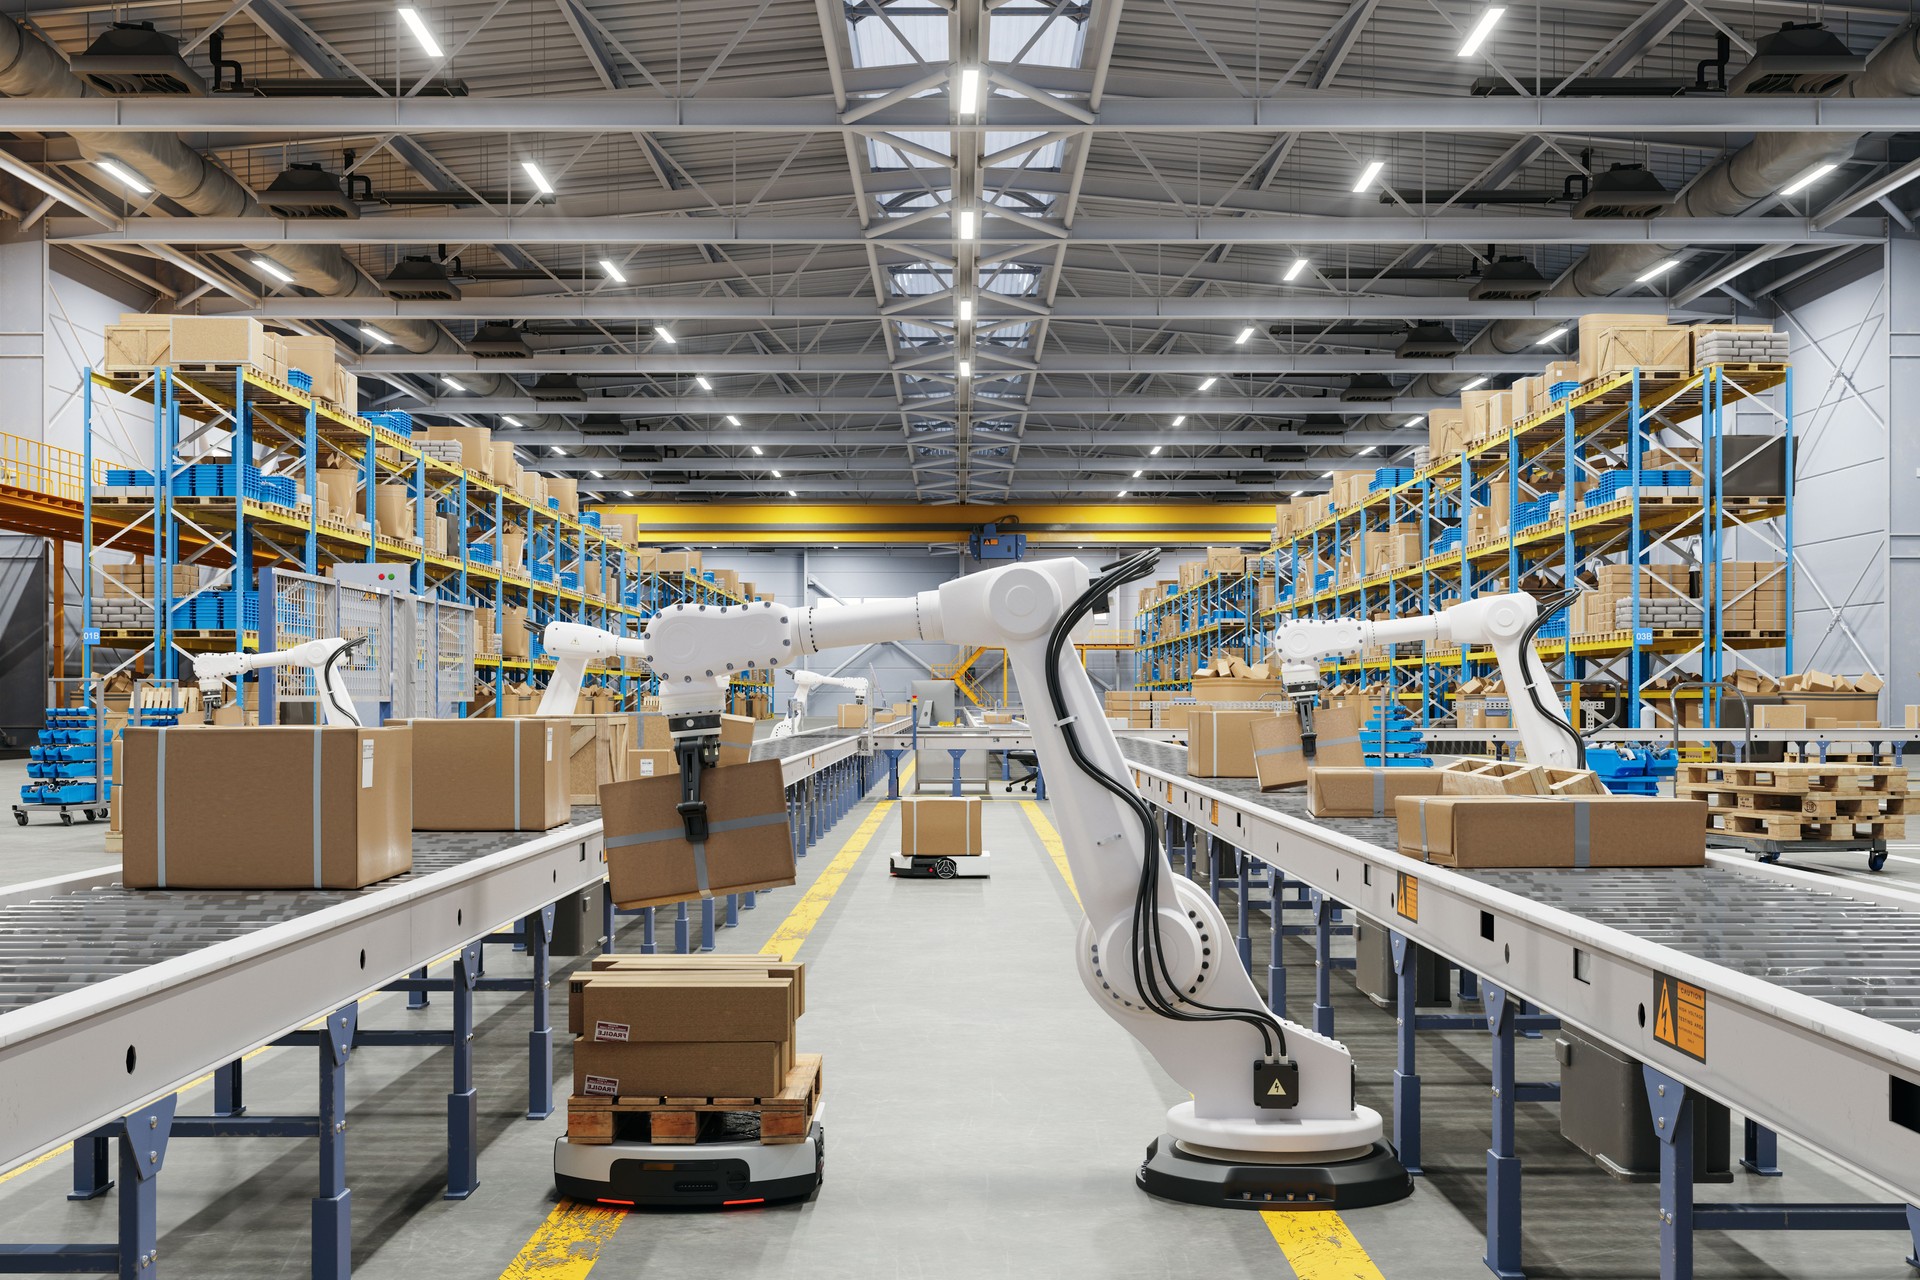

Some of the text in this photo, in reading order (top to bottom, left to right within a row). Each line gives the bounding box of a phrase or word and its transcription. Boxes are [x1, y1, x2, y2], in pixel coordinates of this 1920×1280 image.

[84, 632, 99, 640] 01B
[1636, 632, 1652, 640] 03B
[1680, 987, 1702, 1000] CAUTION
